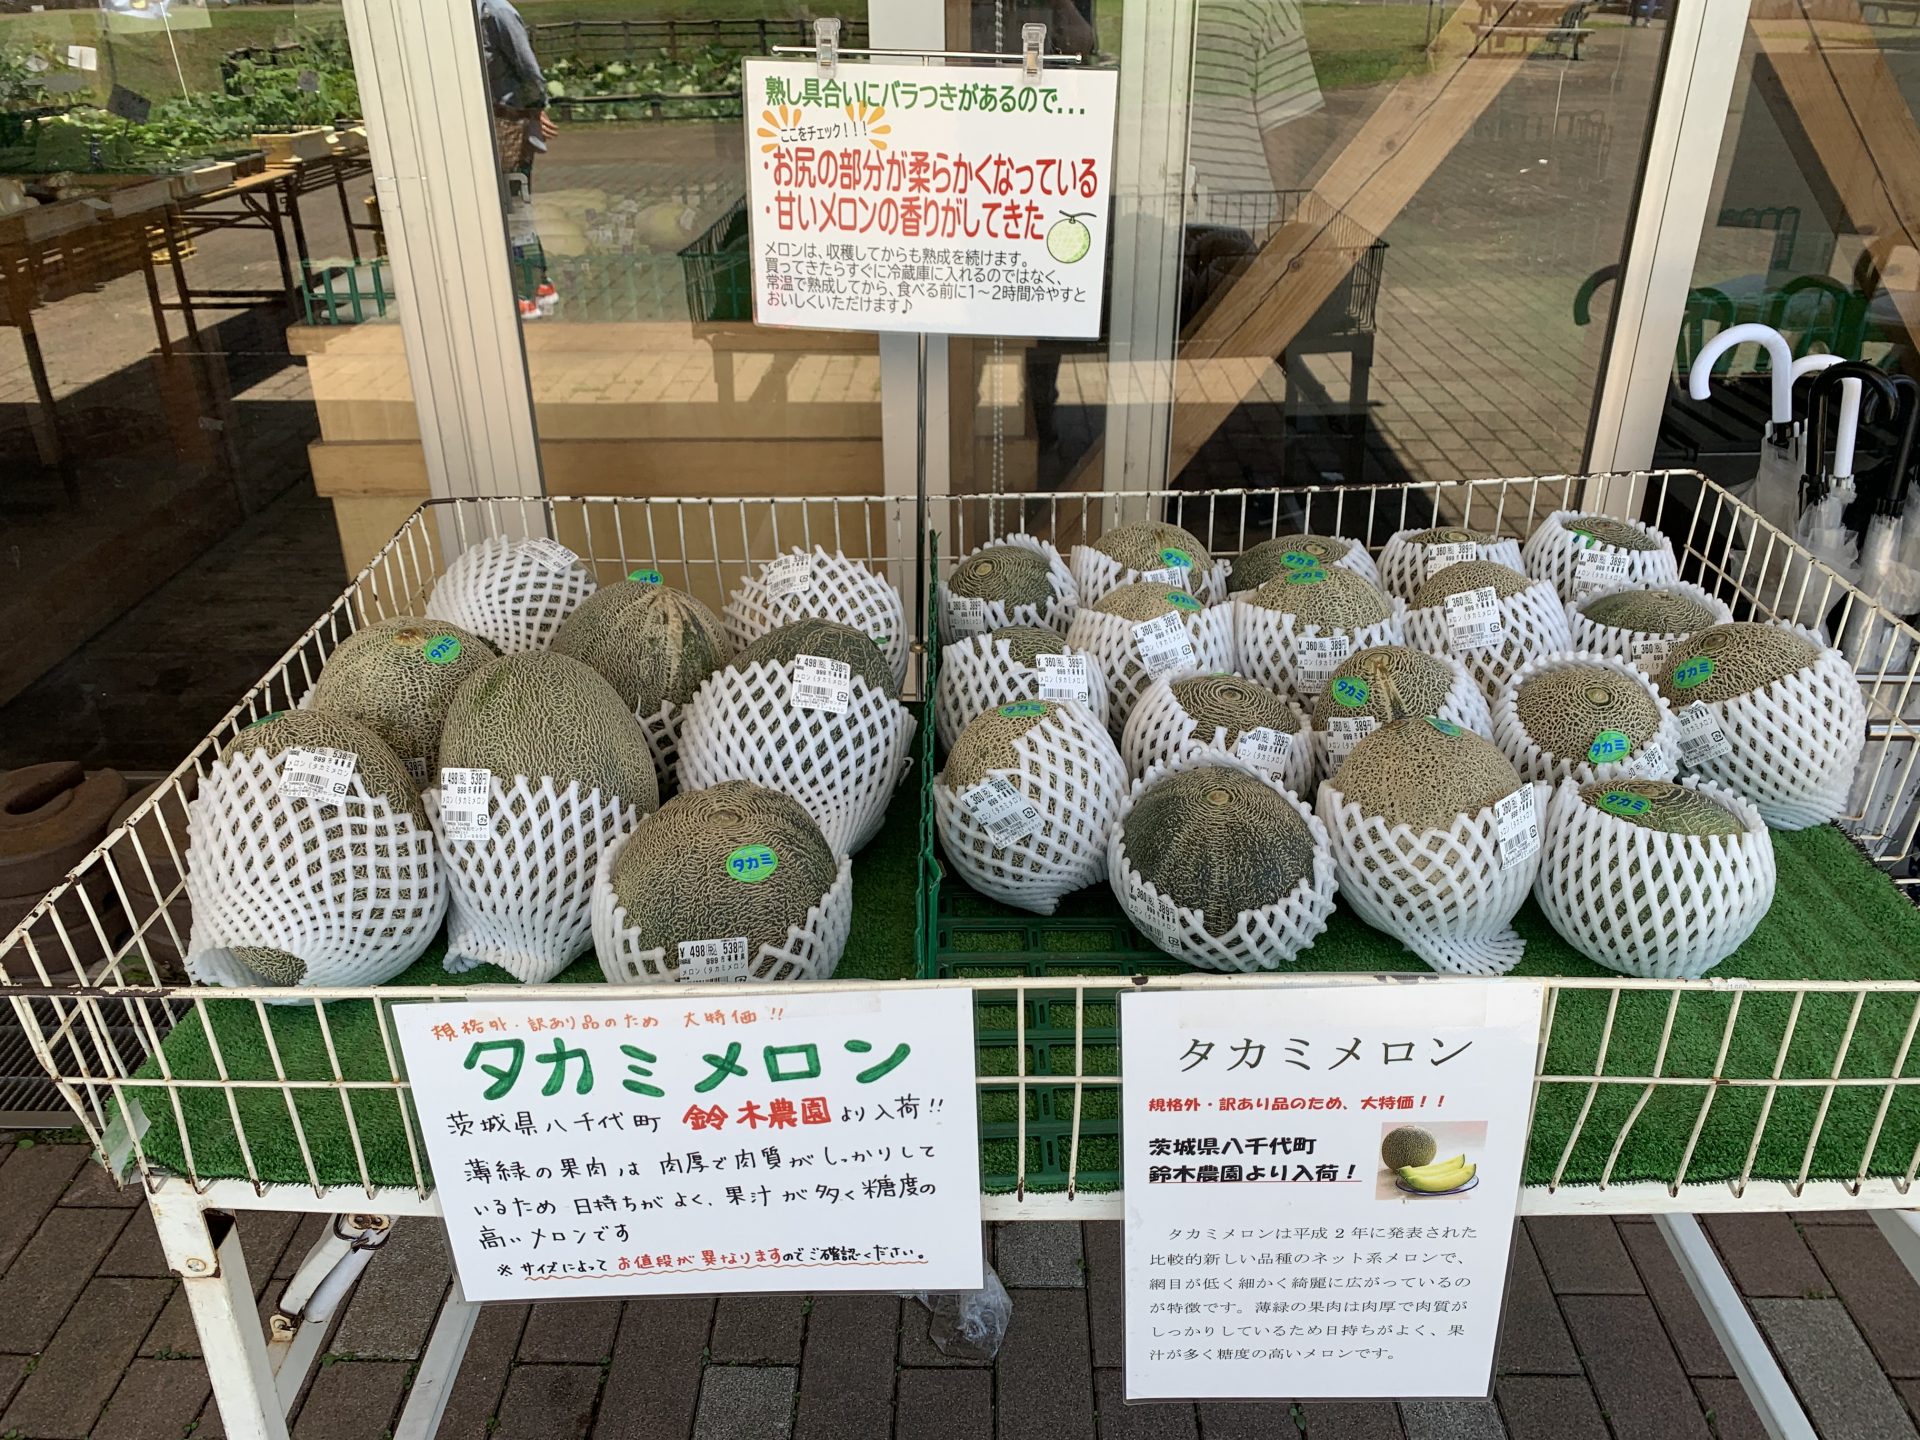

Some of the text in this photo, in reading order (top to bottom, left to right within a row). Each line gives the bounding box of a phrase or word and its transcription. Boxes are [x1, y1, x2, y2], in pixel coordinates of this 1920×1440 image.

[765, 241, 1029, 267] メロンは、収穫してからも熟成を続けます。
[765, 259, 1063, 286] 買ってきたらすぐに冷蔵庫に入れるのではなく、
[1452, 597, 1463, 607] 360
[430, 638, 456, 658] タカミ
[1306, 641, 1318, 651] 360
[1667, 641, 1681, 652] 389
[804, 658, 817, 667] 498
[1045, 657, 1056, 667] 360
[1677, 662, 1710, 682] タカミ
[1338, 681, 1366, 701] タカミ
[1592, 739, 1625, 756] タカミ
[448, 772, 458, 784] 498
[970, 792, 985, 805] 360
[1607, 795, 1646, 812] タカミ
[733, 853, 774, 873] タカミ
[690, 945, 705, 958] 498
[684, 1007, 785, 1029] 大特価!!
[1179, 1037, 1473, 1073] タカミメロン
[463, 1036, 912, 1100] タカミメロン
[1148, 1093, 1447, 1113] 規格外・訳あり品のため、大特価！！
[447, 1109, 661, 1138] 茨城県八千代町
[1149, 1137, 1317, 1157] 茨城県八千代町
[1149, 1163, 1357, 1183] 鈴木農園より入荷！
[479, 1223, 631, 1251] 高いメロンです
[1150, 1251, 1465, 1267] 比較的新しい品種のネット系メロンで、
[1150, 1276, 1472, 1291] 網目が低く細かく綺麗に広がっているの
[1150, 1300, 1468, 1315] が特徴です。薄緑の果肉は肉厚で肉質が
[1152, 1323, 1466, 1338] しっかりしているため日持ちがよく、果
[1150, 1347, 1396, 1361] 汁が多く糖度の高いメロンです。
